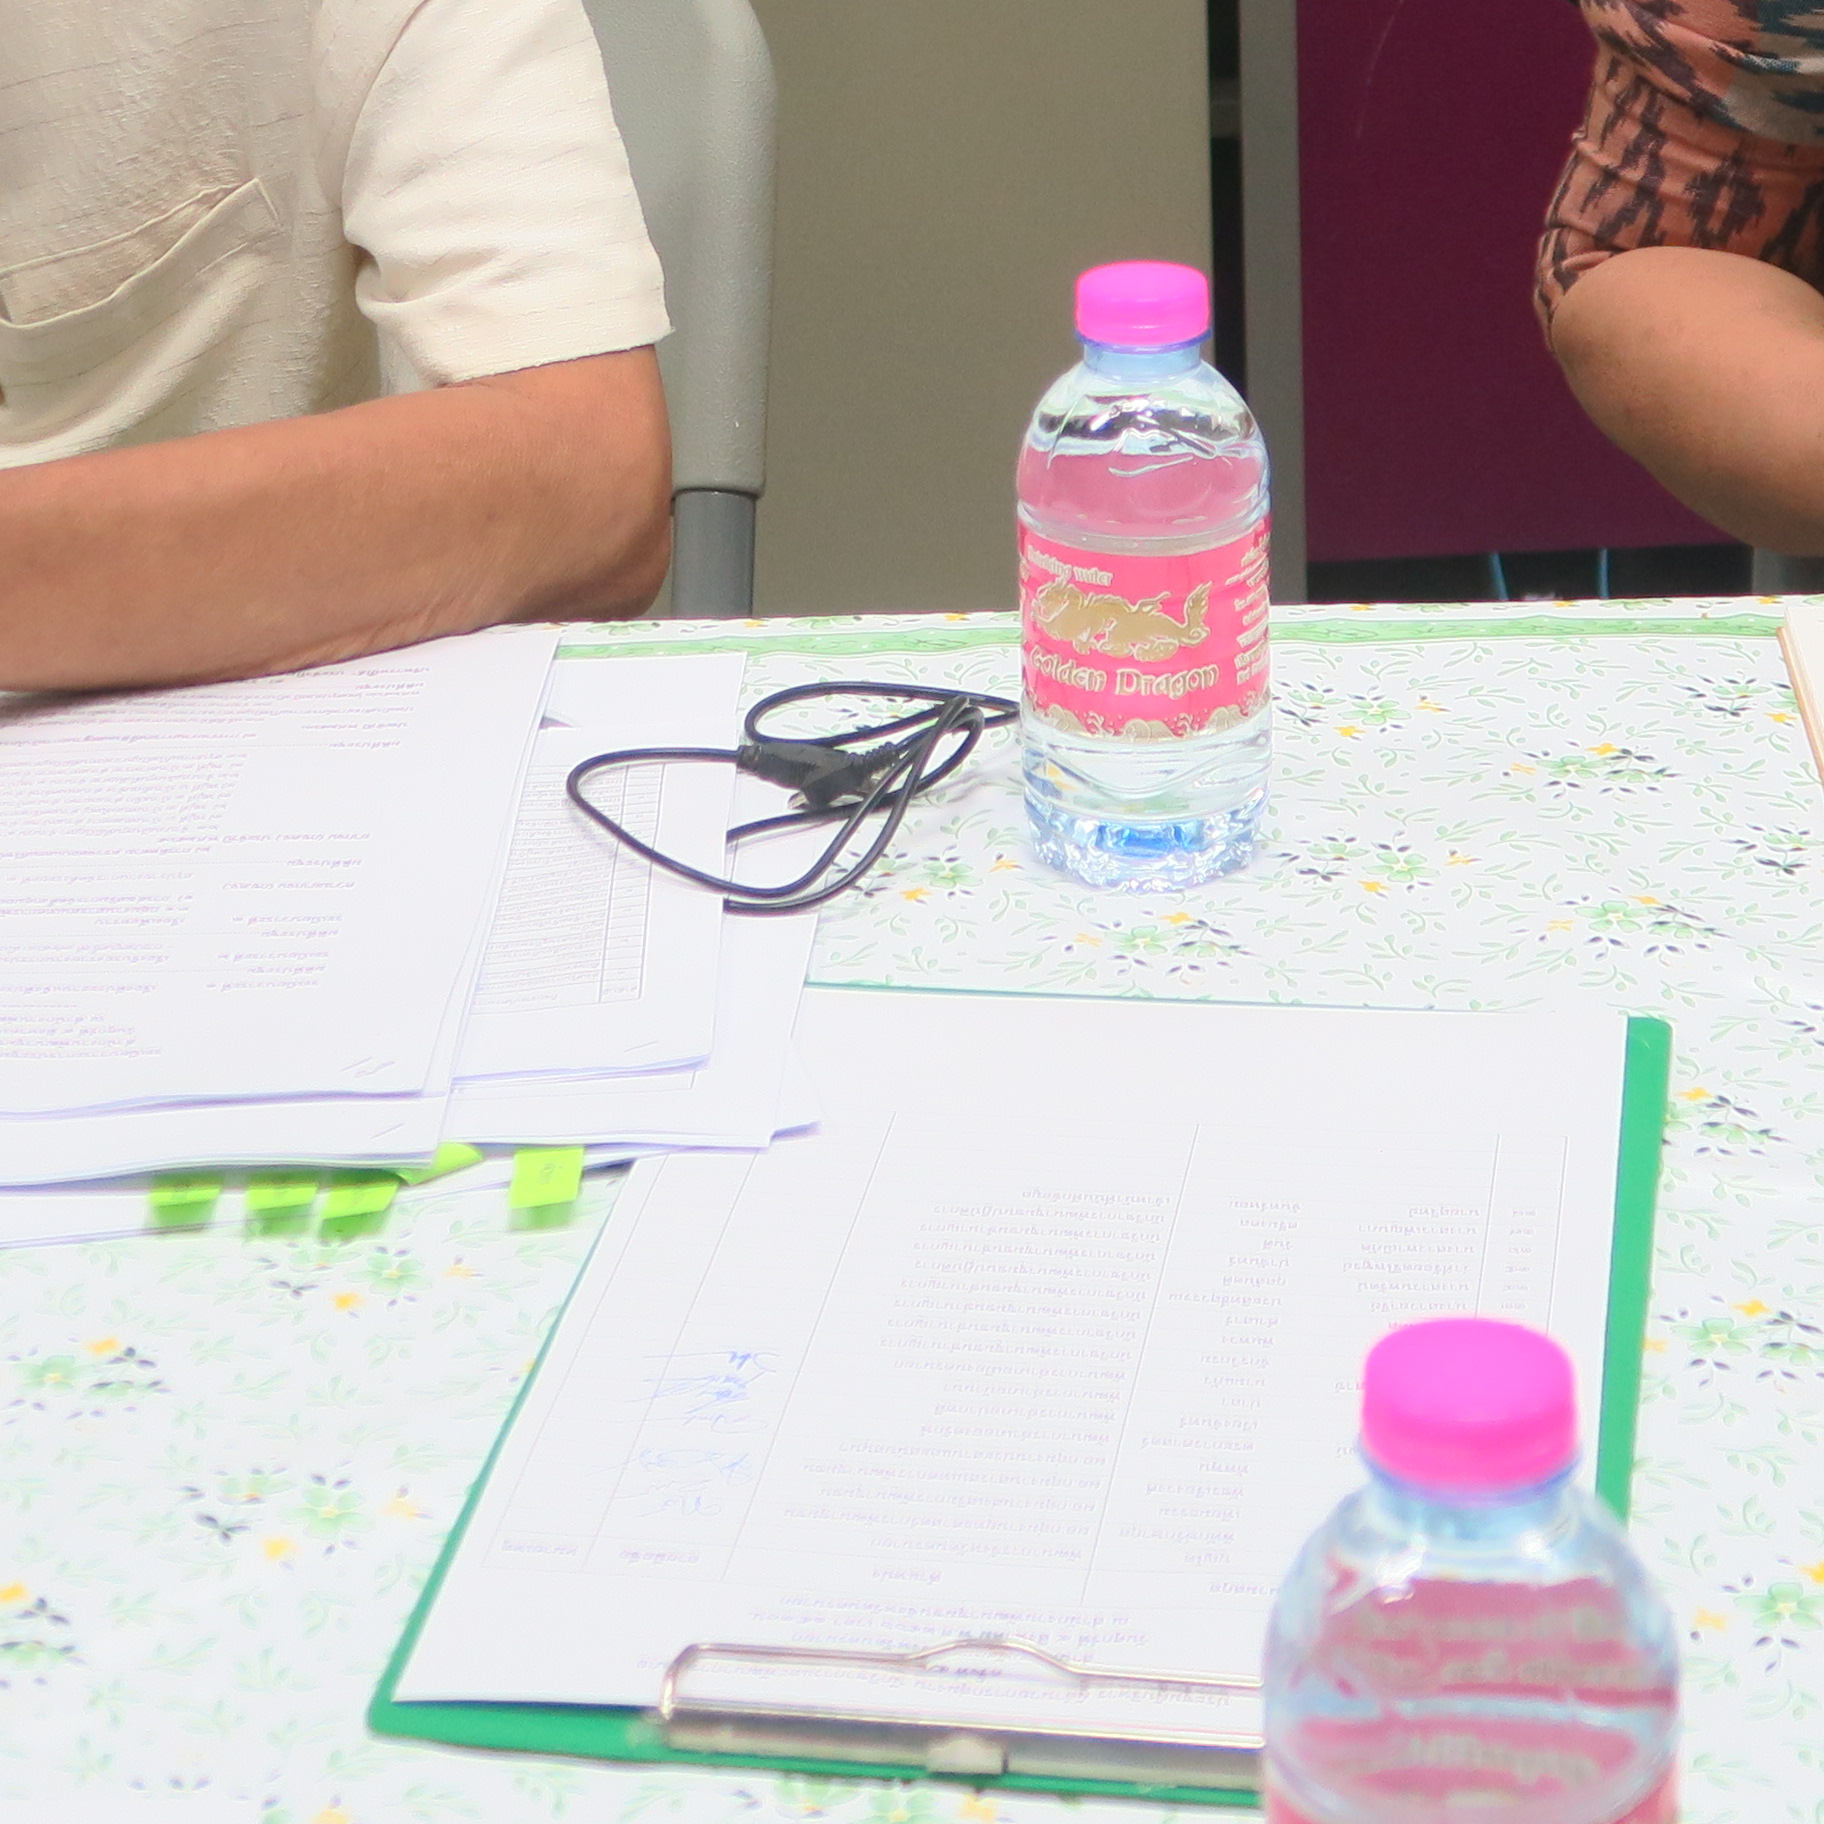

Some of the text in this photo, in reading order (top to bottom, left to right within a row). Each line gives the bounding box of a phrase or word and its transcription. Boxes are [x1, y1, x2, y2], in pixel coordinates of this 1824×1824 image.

[1074, 566, 1114, 587] water
[1029, 646, 1220, 701] Golden Dragon
